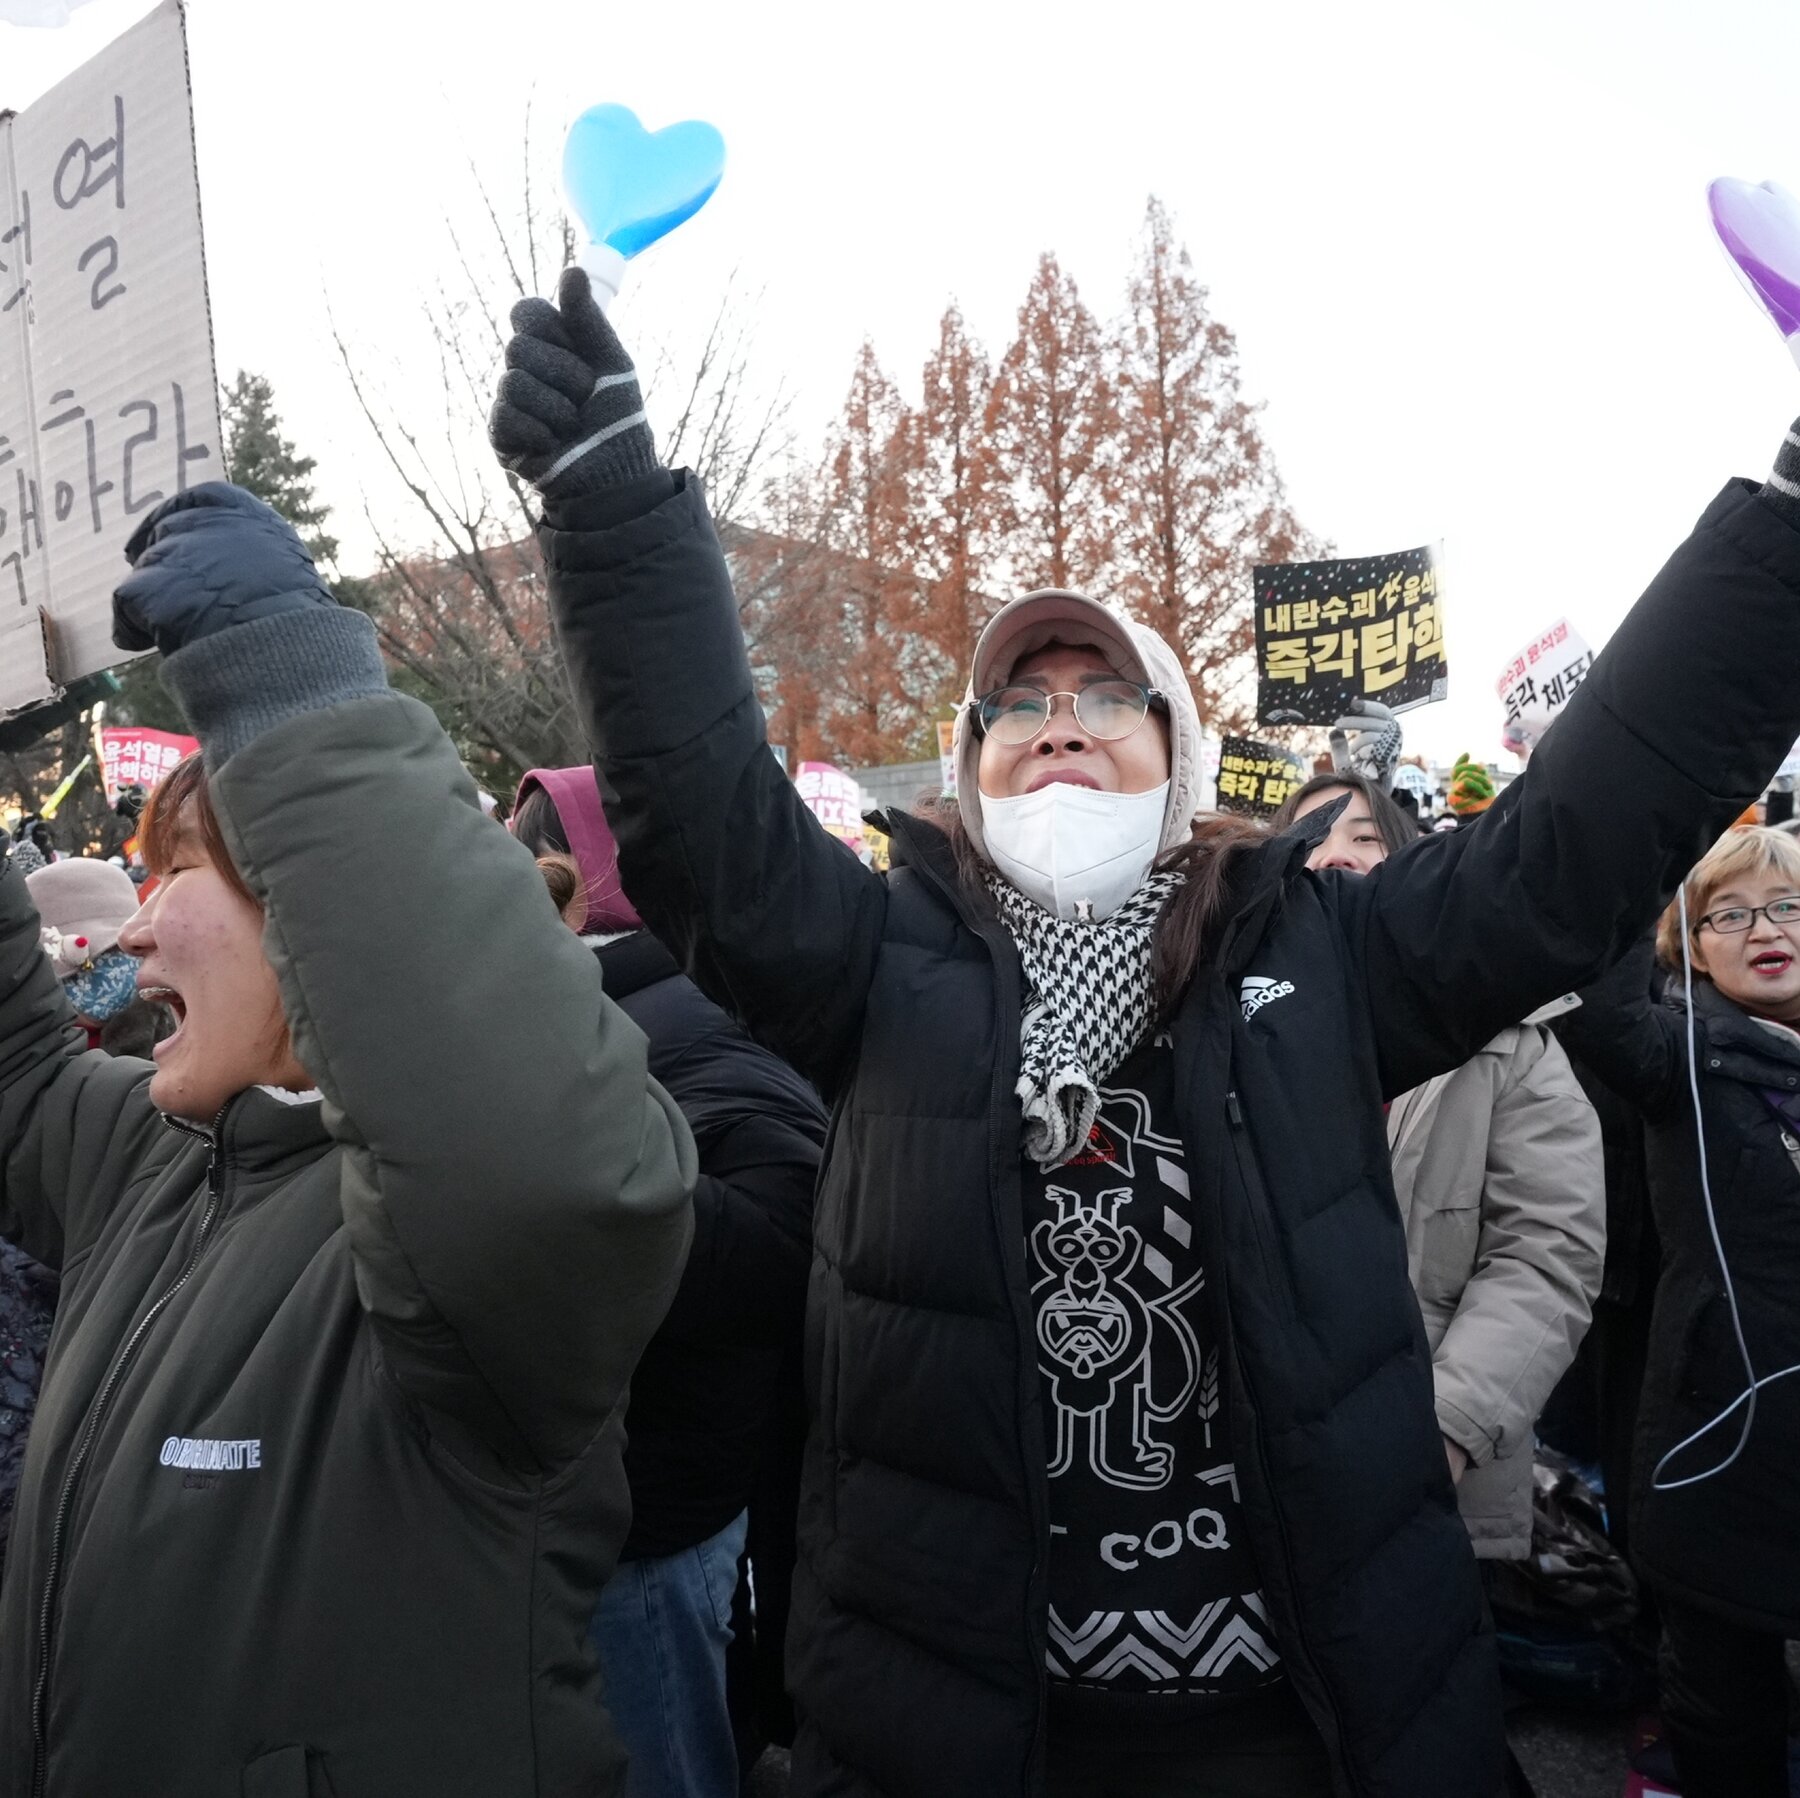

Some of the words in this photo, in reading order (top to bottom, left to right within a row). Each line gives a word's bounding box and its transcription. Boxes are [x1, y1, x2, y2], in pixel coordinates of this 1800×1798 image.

[1264, 588, 1376, 632] 내란수괴
[1265, 629, 1358, 684] 즉각
[104, 740, 181, 768] 윤석열을
[105, 761, 170, 786] 탄핵하
[1218, 771, 1259, 801] 즉각
[1100, 1507, 1231, 1572] COQ
